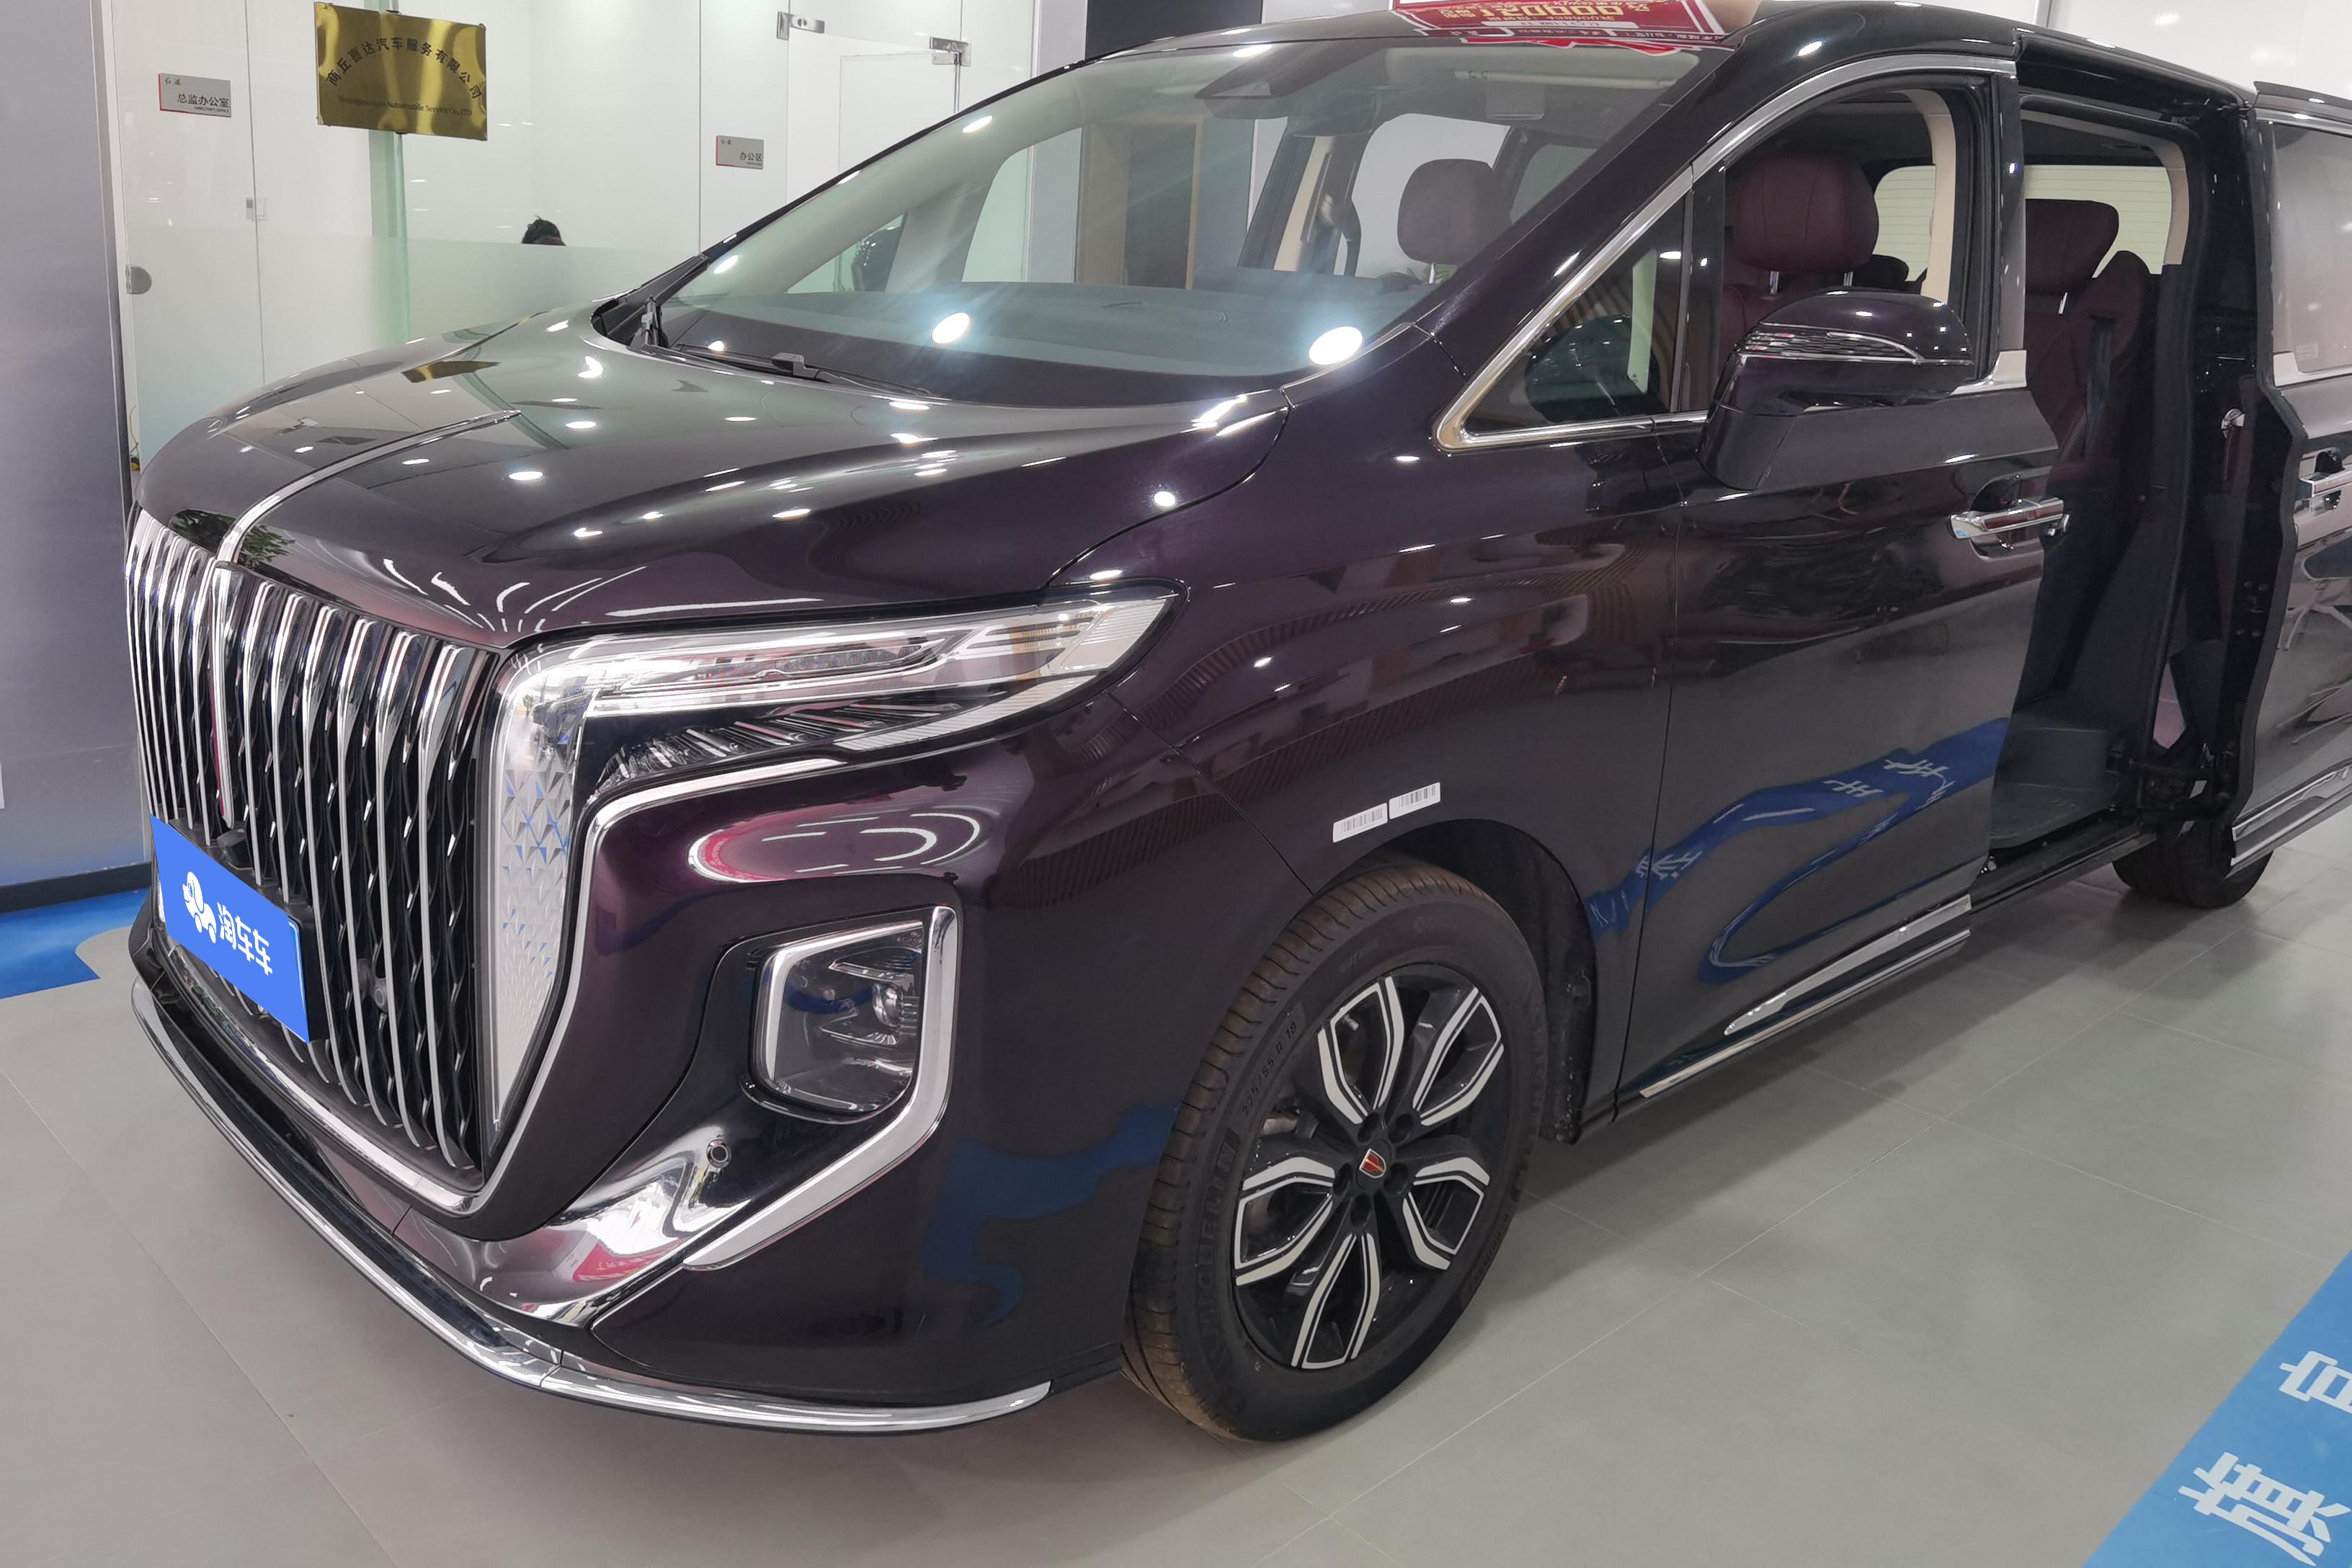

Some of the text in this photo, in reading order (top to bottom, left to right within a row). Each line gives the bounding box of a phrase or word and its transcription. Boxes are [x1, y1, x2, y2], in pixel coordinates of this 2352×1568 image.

[177, 93, 229, 107] 总监办公室
[739, 151, 762, 161] 办公区
